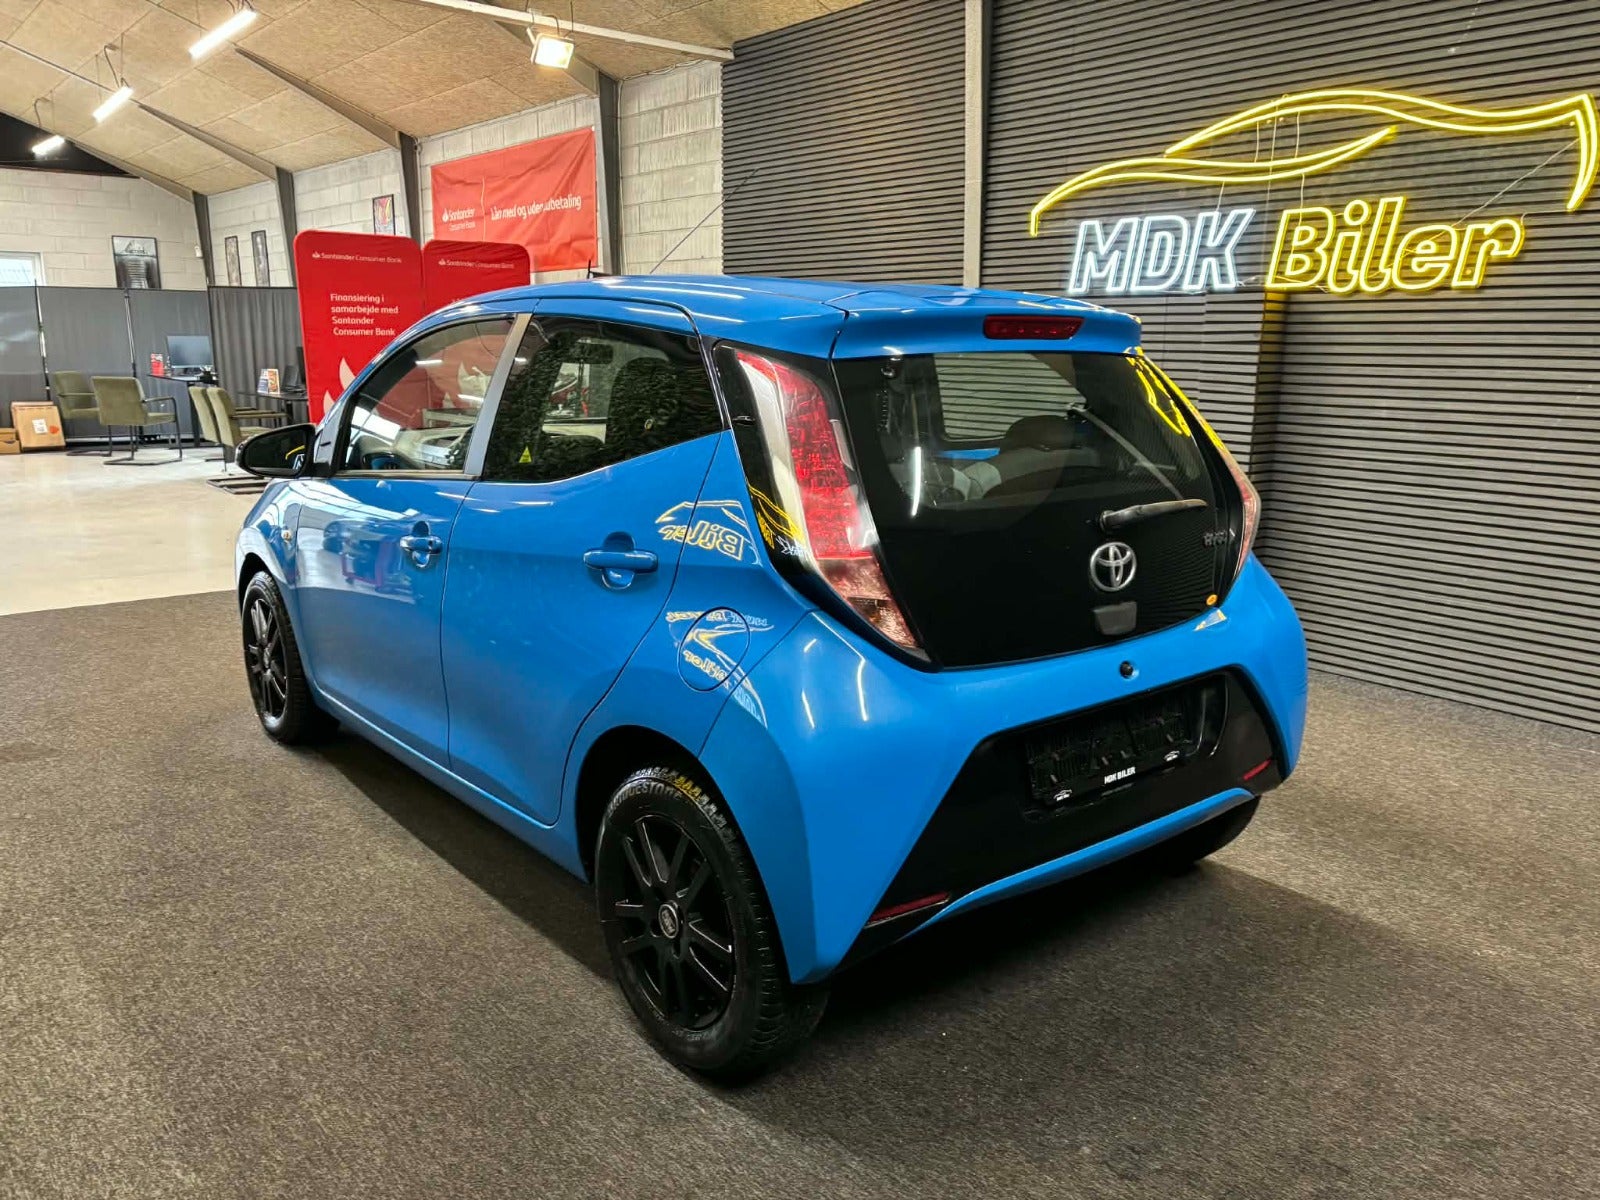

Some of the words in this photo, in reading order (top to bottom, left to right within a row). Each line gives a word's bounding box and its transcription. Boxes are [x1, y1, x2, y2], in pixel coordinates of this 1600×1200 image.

[502, 204, 517, 219] med
[517, 206, 527, 220] og
[1068, 208, 1256, 294] MDK
[1264, 196, 1525, 295] Biler
[321, 252, 355, 261] Santander
[355, 254, 386, 263] Consumer
[386, 256, 402, 264] Bank
[446, 259, 474, 268] Santander
[330, 293, 381, 305] Finansiering
[381, 293, 385, 303] i
[330, 305, 380, 315] samarbejde
[380, 305, 399, 314] med
[331, 315, 375, 325] Santander
[332, 326, 374, 336] Consumer
[375, 327, 396, 336] Bank
[1117, 766, 1136, 780] BILER
